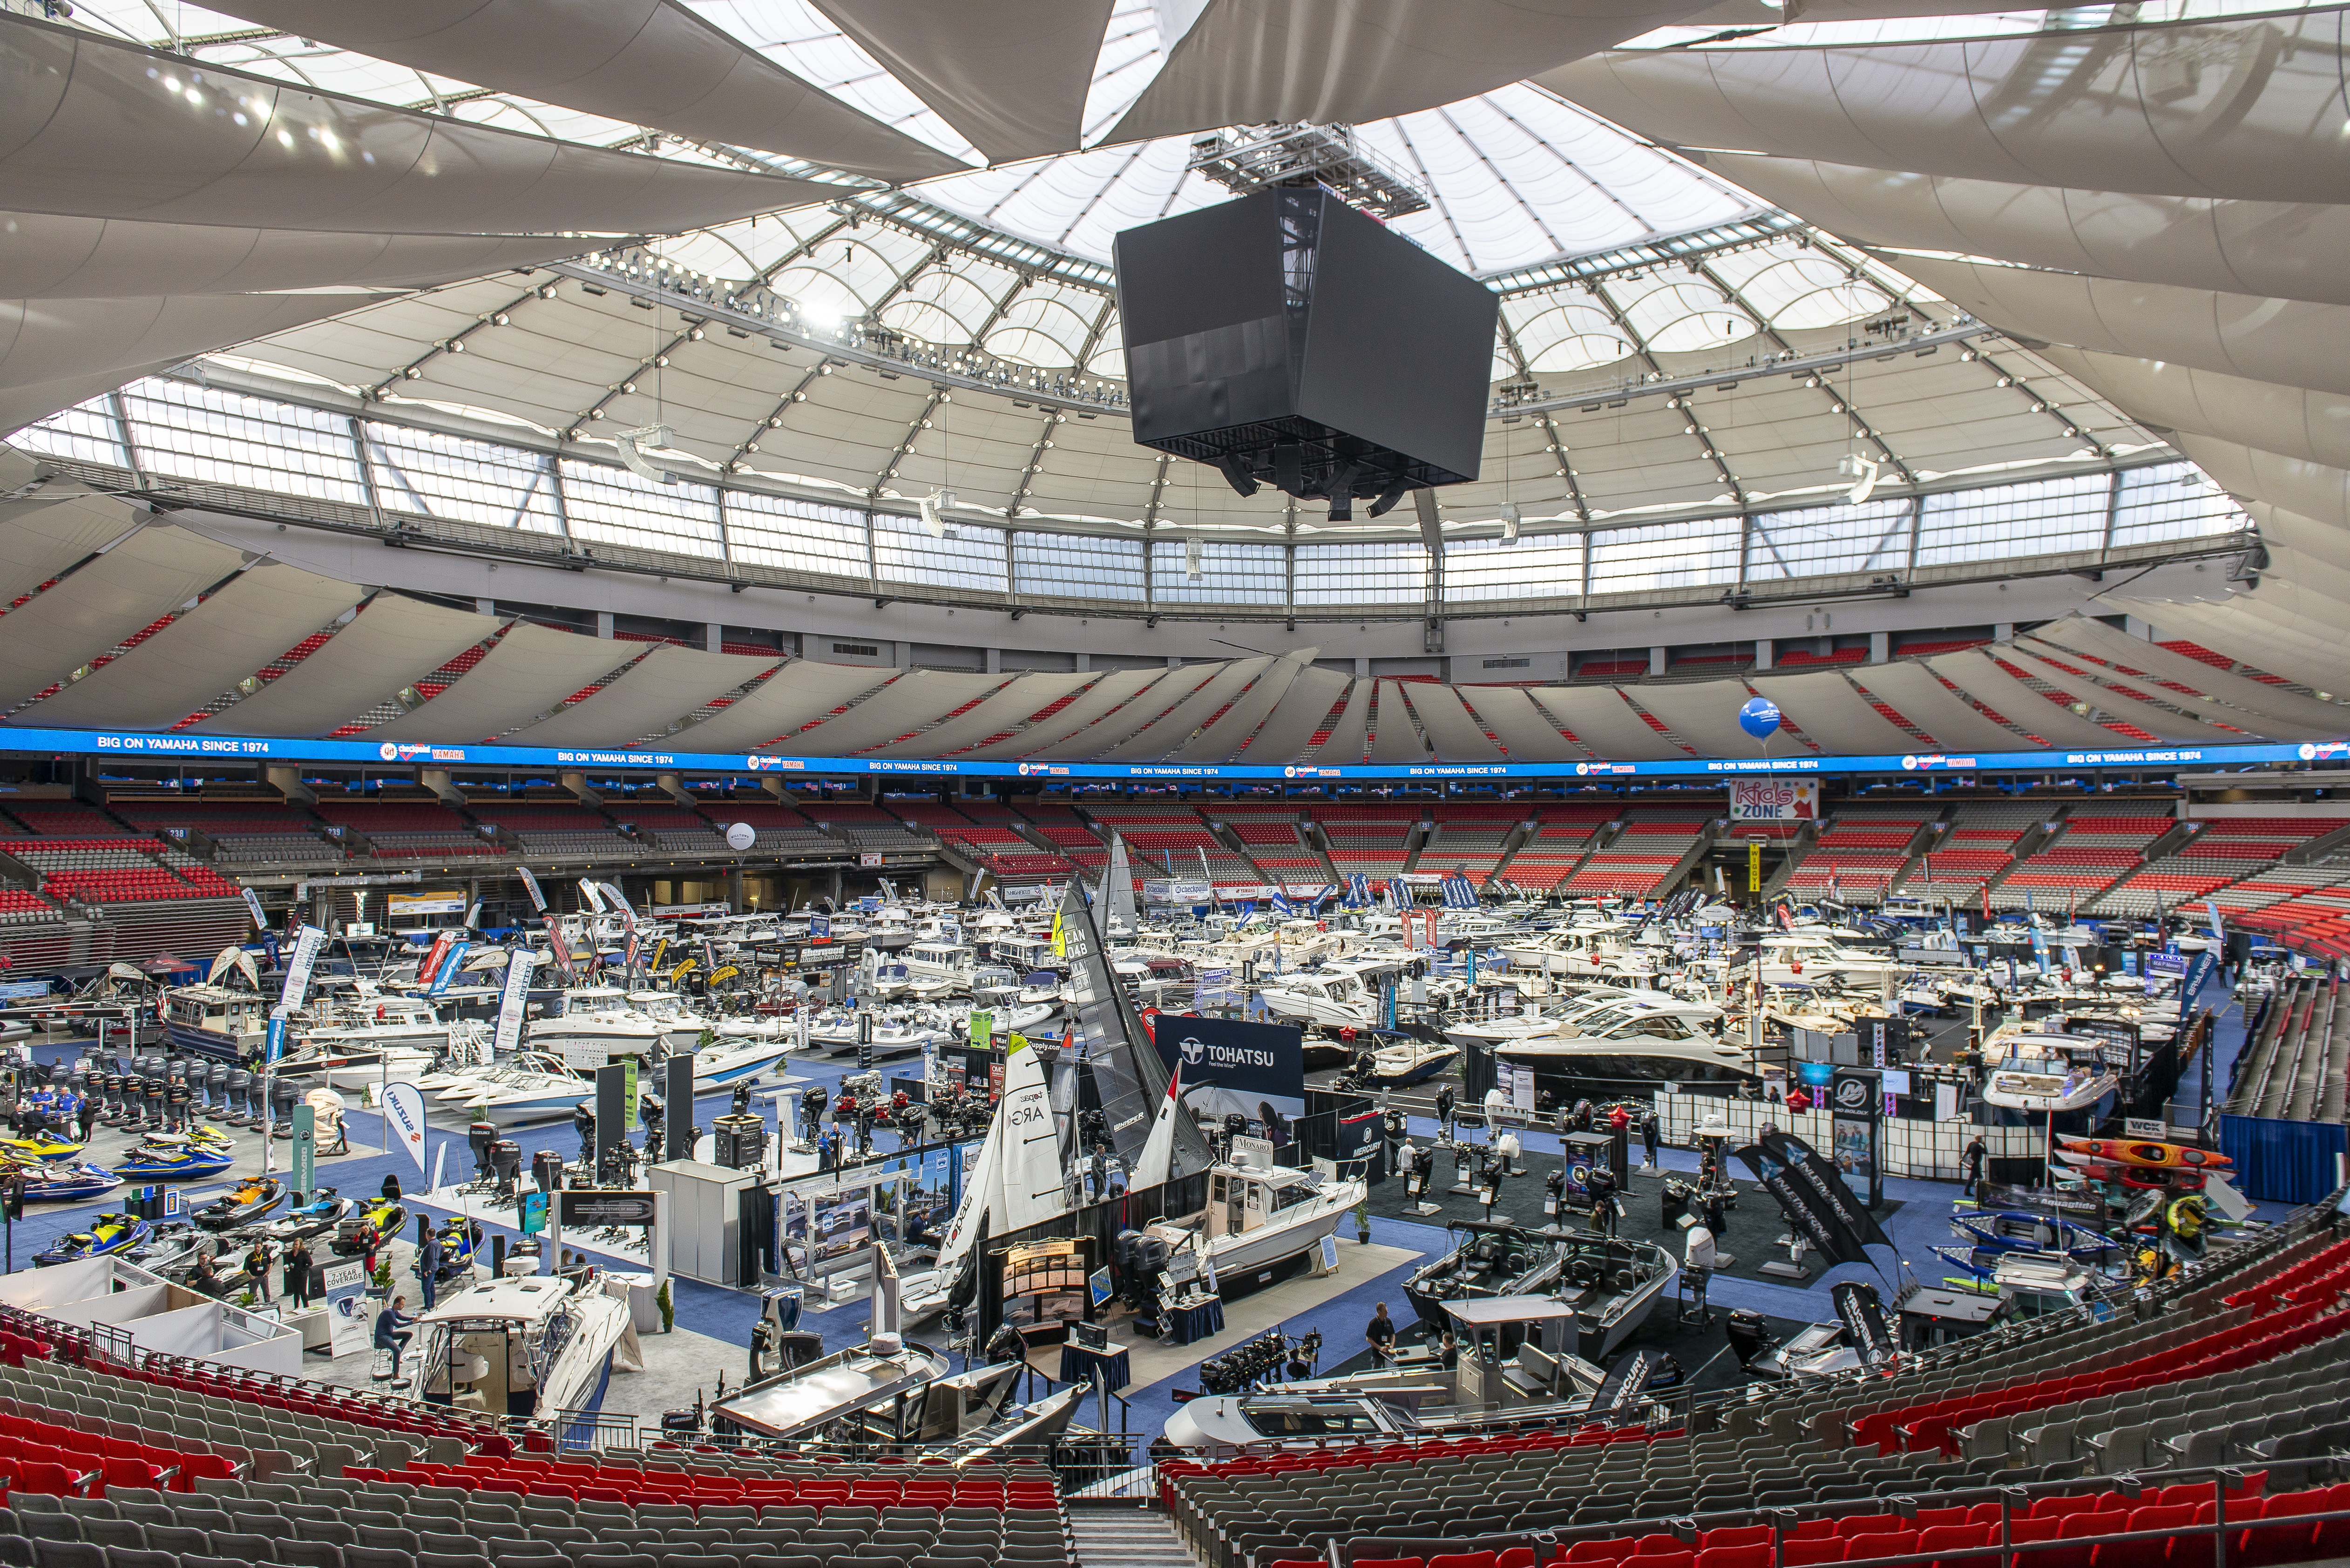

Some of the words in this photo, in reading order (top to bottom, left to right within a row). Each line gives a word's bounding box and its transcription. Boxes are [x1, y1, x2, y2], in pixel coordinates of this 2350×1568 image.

[97, 737, 120, 748] BIG
[124, 738, 144, 749] ON
[146, 738, 199, 750] YAMAHA
[202, 740, 239, 751] SINCE
[242, 742, 269, 752] 1974
[433, 750, 464, 760] YAMAHA
[558, 752, 574, 761] BIG
[576, 753, 589, 761] ON
[591, 753, 626, 762] YAMAHA
[628, 755, 653, 763] SINCE
[2067, 755, 2085, 763] BIG
[2086, 754, 2101, 763] ON
[2102, 753, 2144, 762] YAMAHA
[2146, 752, 2176, 761] SINCE
[2179, 751, 2201, 760] 1974
[782, 761, 804, 769] YAMAHA
[1736, 781, 1794, 805] Kids
[1742, 804, 1783, 818] ZONE
[1065, 929, 1086, 944] CAN
[300, 936, 314, 967] MARINE
[306, 937, 320, 969] RICHMOND
[802, 946, 845, 956] Sherwood
[1067, 942, 1088, 959] 048
[427, 941, 447, 976] KINGFISHER
[441, 947, 465, 987] KINGFISHER
[2186, 953, 2214, 996] BAYLINER
[508, 959, 521, 997] GALLEON
[514, 960, 527, 1000] MARINE
[520, 961, 532, 1000] RICHMOND
[1012, 1040, 1023, 1048] ARGO
[1207, 1045, 1273, 1067] TOHATSU
[909, 1112, 922, 1121] SUZUKI
[1113, 1112, 1145, 1132] WHISPER
[2130, 1120, 2161, 1132] WCK
[1237, 1137, 1269, 1151] MONARO
[1353, 1141, 1382, 1157] MERCURY
[2040, 1197, 2096, 1210] Aquaglide
[946, 1194, 973, 1250] topaz
[327, 1273, 363, 1286] COVERAGE
[332, 1269, 357, 1279] 7-YEAR
